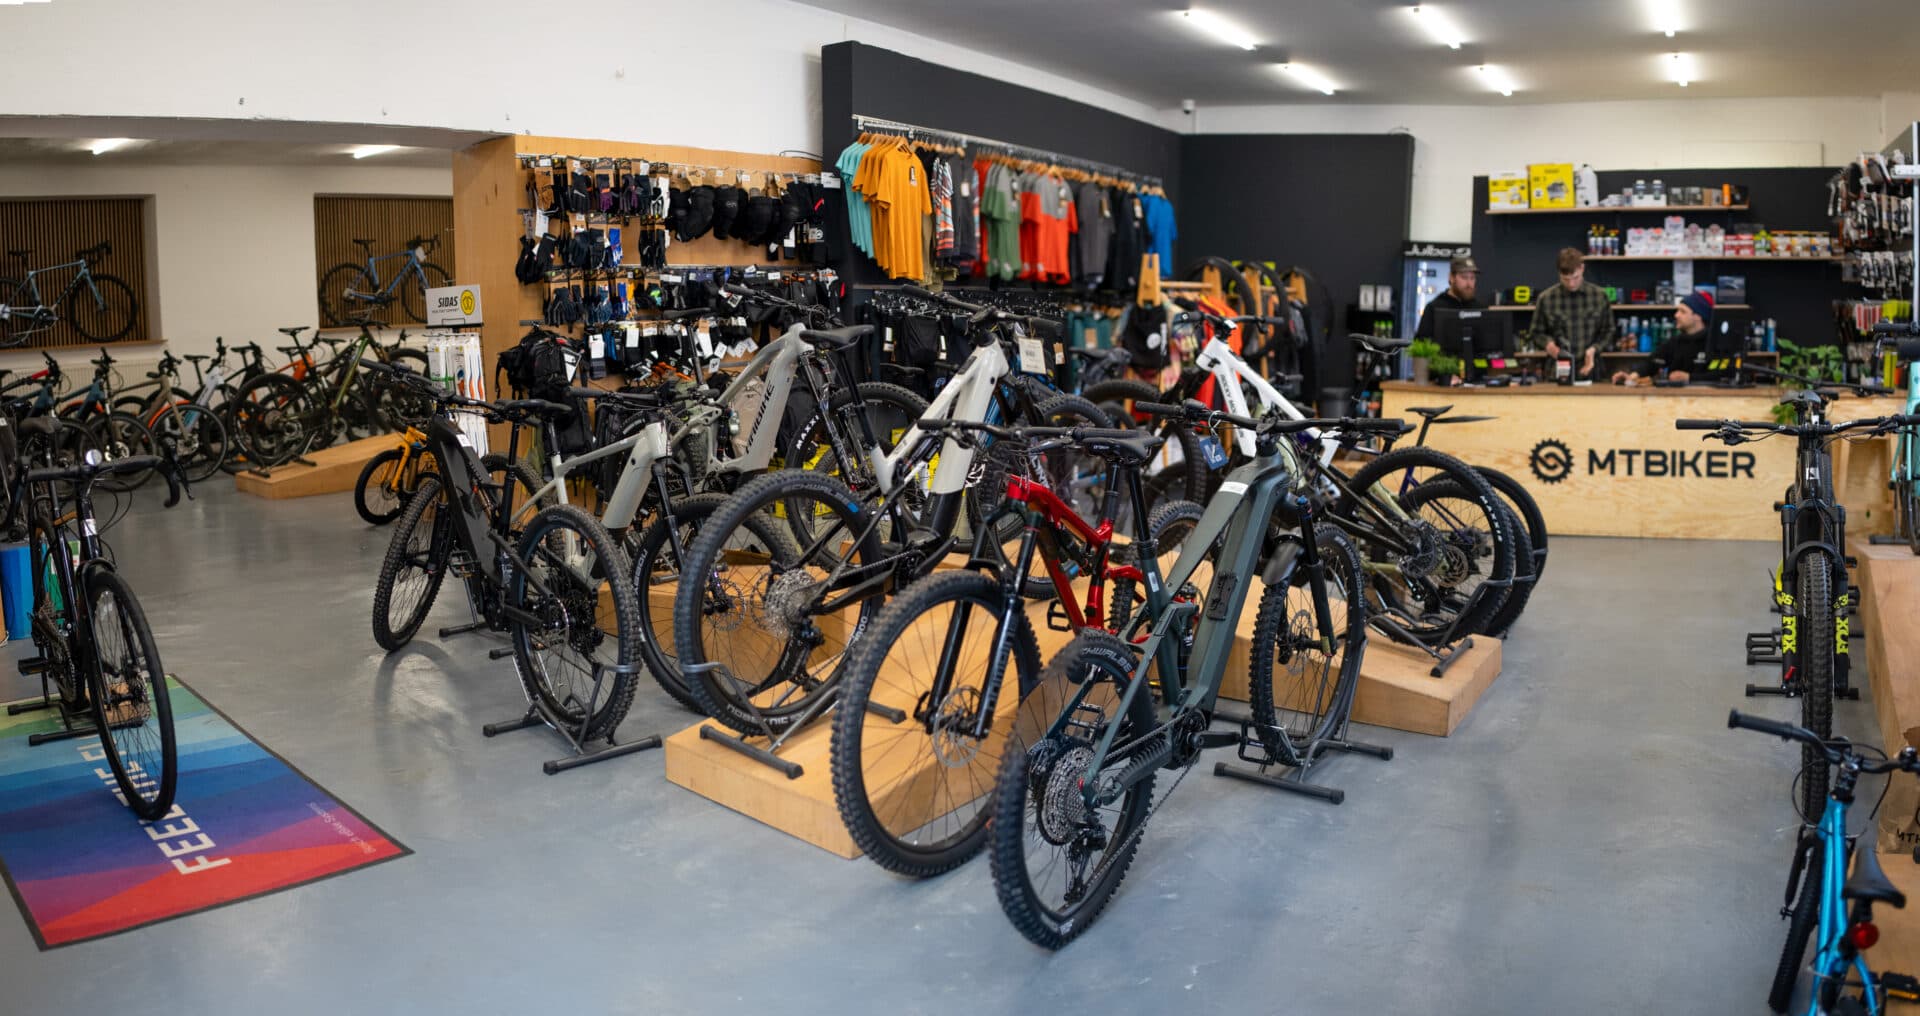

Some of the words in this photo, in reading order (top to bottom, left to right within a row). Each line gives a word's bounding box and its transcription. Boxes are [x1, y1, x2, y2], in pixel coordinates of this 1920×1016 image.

[438, 296, 458, 308] SIDAS
[796, 415, 819, 449] MAXXI
[1588, 449, 1756, 479] MTBIKER
[1782, 615, 1797, 654] FOX
[1836, 615, 1849, 655] FOX
[1081, 647, 1133, 672] CHWALBE
